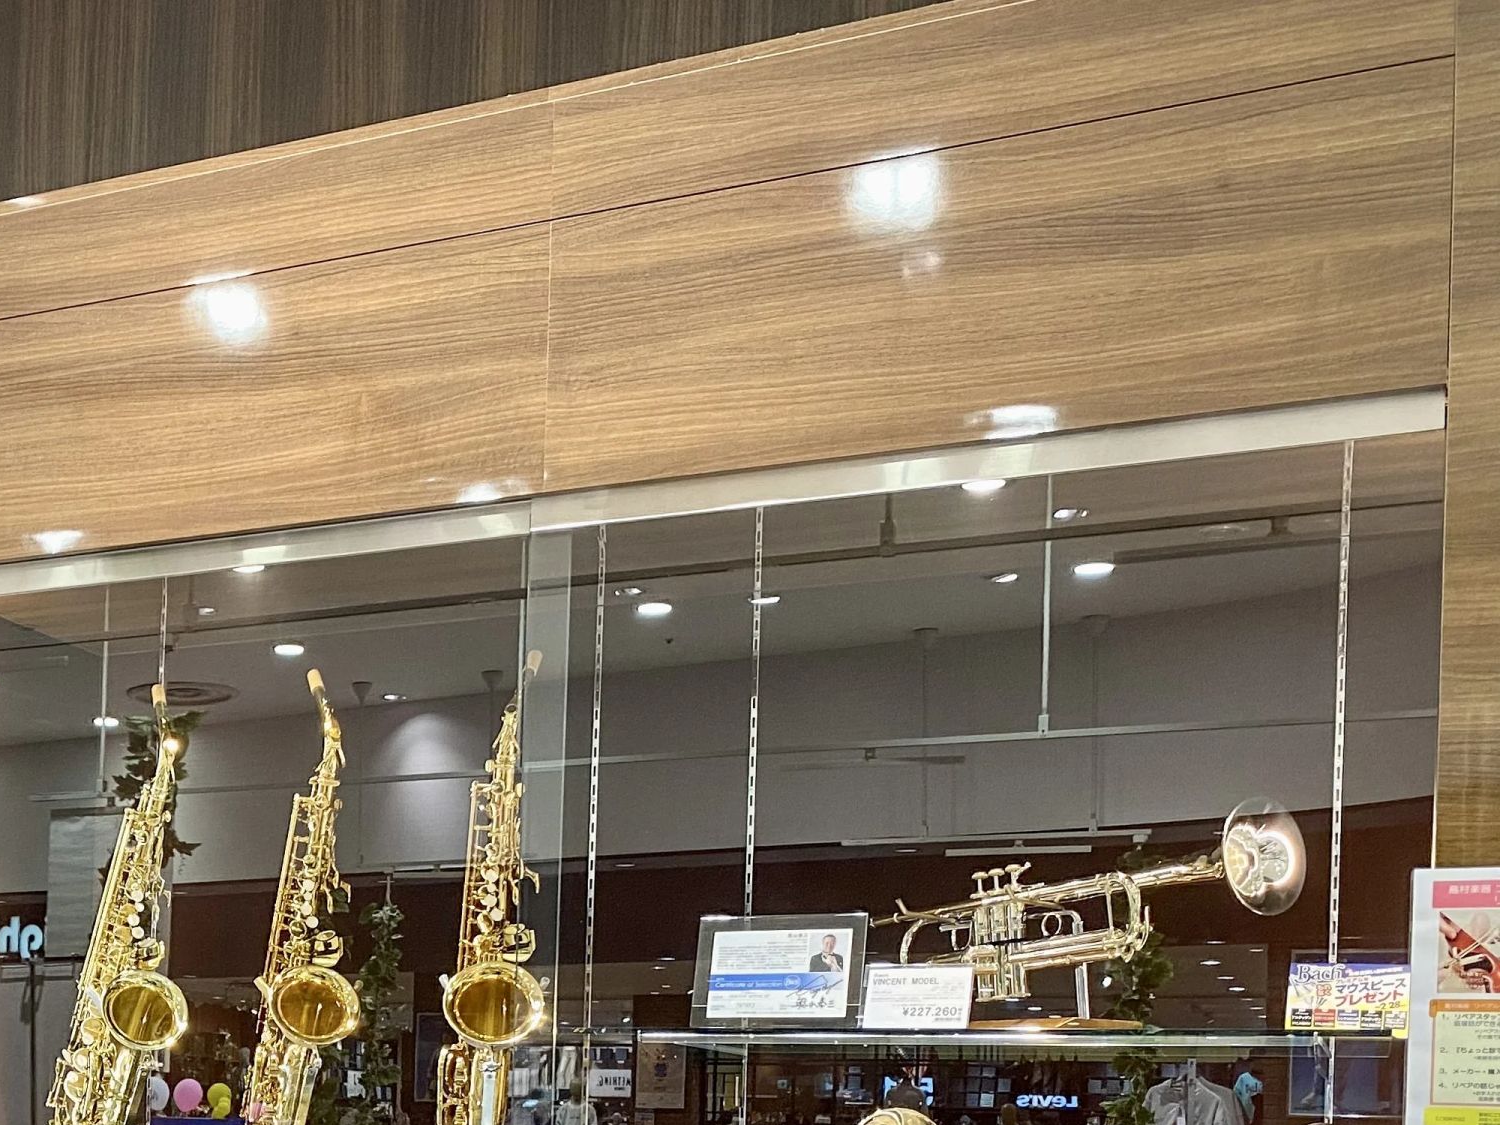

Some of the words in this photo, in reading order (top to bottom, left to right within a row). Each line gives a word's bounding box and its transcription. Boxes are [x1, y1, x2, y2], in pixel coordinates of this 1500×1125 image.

[872, 977, 907, 986] VINCENT
[911, 976, 939, 985] MODEL
[1295, 964, 1346, 982] Bach
[1335, 978, 1407, 993] マウスピース
[1335, 990, 1404, 1007] プレゼント
